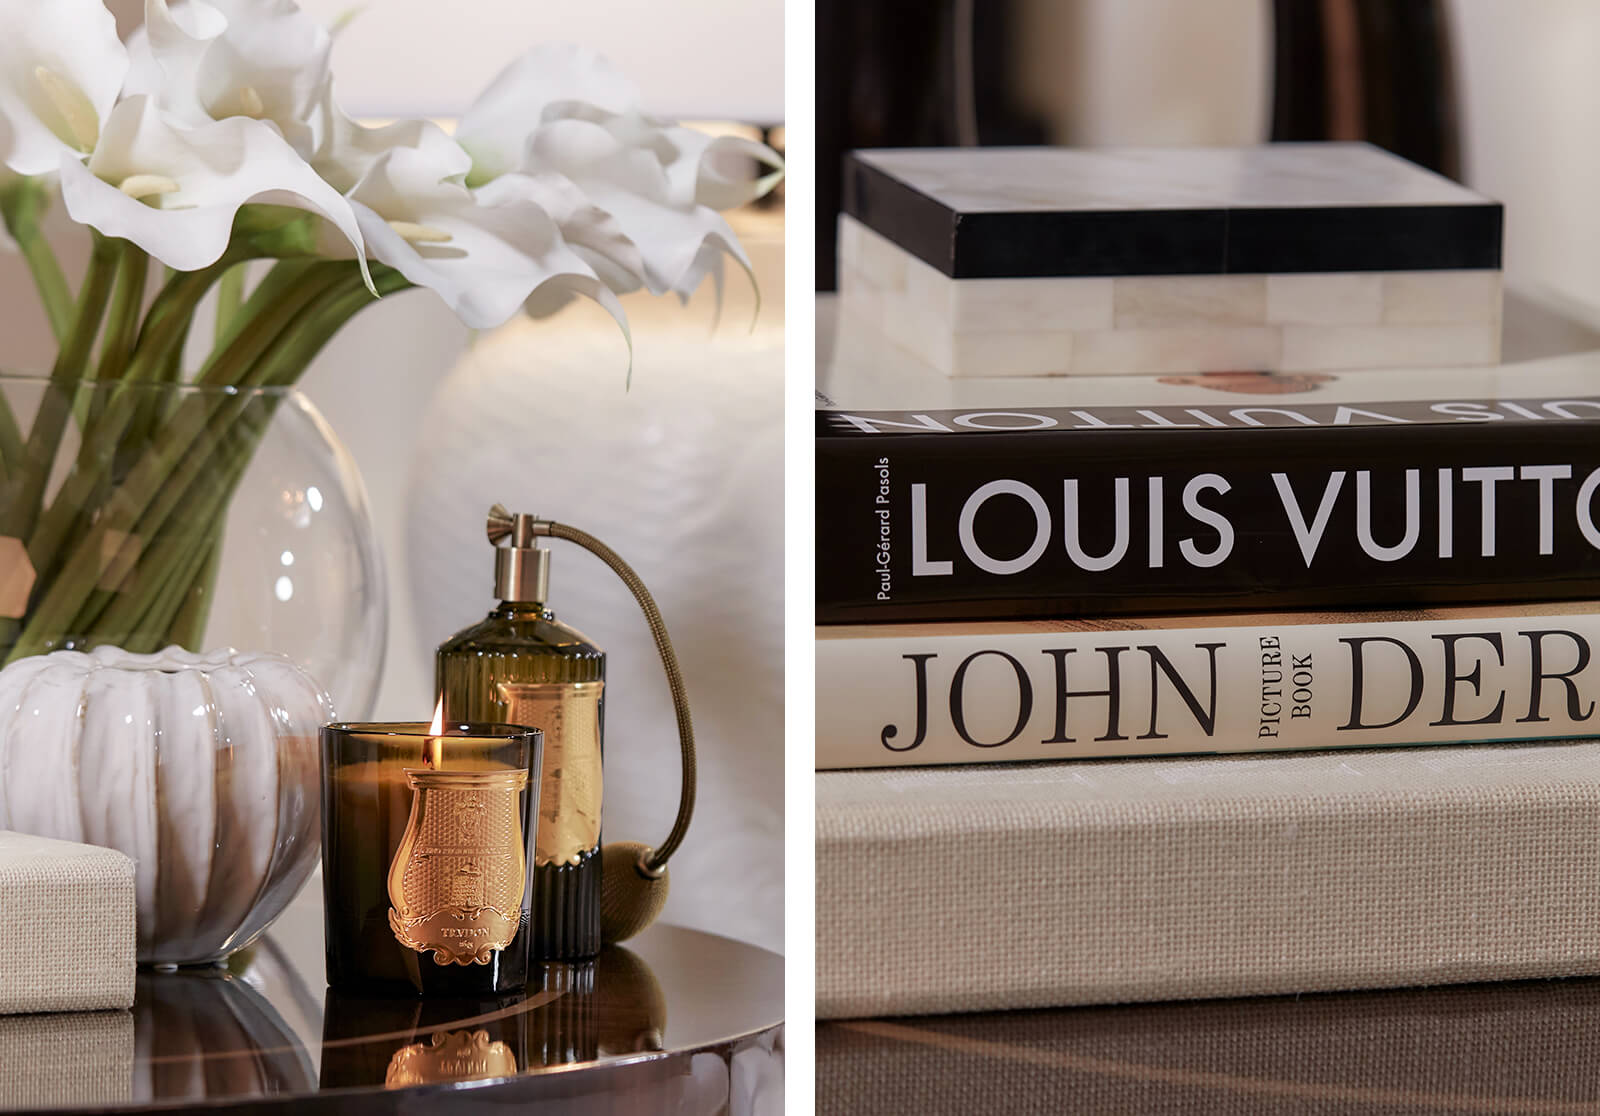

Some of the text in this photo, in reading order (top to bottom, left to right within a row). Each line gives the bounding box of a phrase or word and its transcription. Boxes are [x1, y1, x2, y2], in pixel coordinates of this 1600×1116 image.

[839, 407, 1413, 433] VUITTON
[873, 457, 891, 600] Paul-Gérard Pasols
[910, 463, 1600, 577] LOUIS VUITT
[880, 629, 1596, 752] JOHN DER
[1258, 635, 1283, 739] PICTURE
[1291, 653, 1313, 720] BOOK
